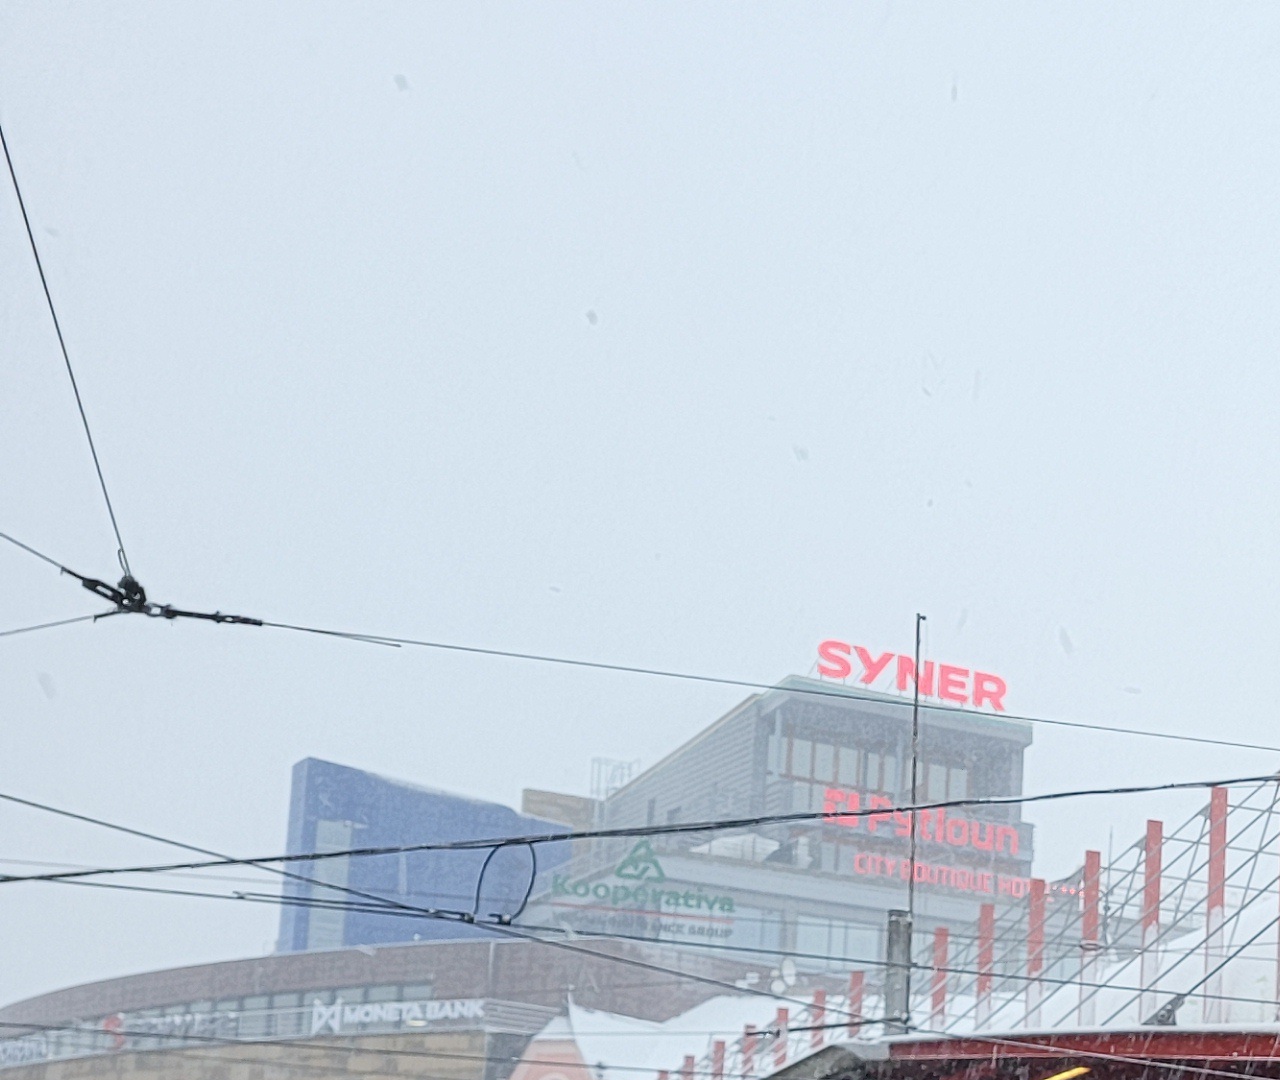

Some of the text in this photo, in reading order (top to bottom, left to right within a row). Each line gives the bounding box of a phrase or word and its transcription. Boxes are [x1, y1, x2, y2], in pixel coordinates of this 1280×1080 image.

[817, 640, 1008, 711] SYNER
[868, 795, 1020, 856] Pytloun
[552, 874, 736, 913] Kooperativa
[854, 853, 897, 876] CITY
[902, 862, 993, 894] BOUTIQUE
[343, 1000, 486, 1023] MONETA BANK
